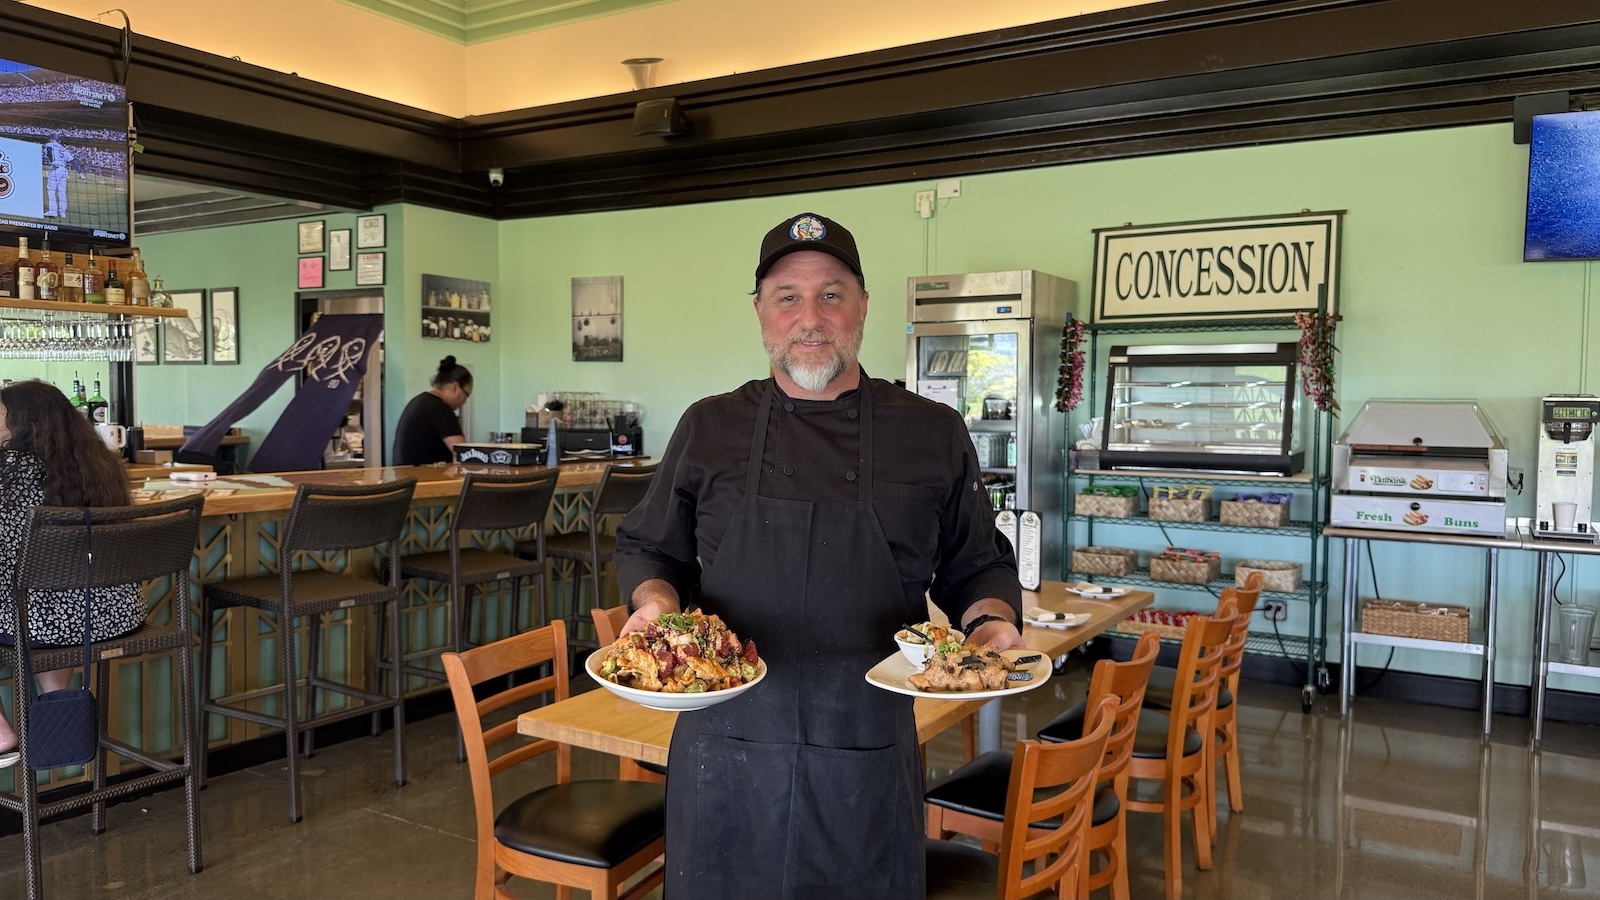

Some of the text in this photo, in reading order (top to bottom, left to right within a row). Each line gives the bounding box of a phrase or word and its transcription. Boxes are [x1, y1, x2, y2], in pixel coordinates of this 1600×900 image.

[9, 220, 37, 228] PRESENTED
[1115, 241, 1315, 301] CONCESSION
[1356, 511, 1479, 528] Fresh Buns
